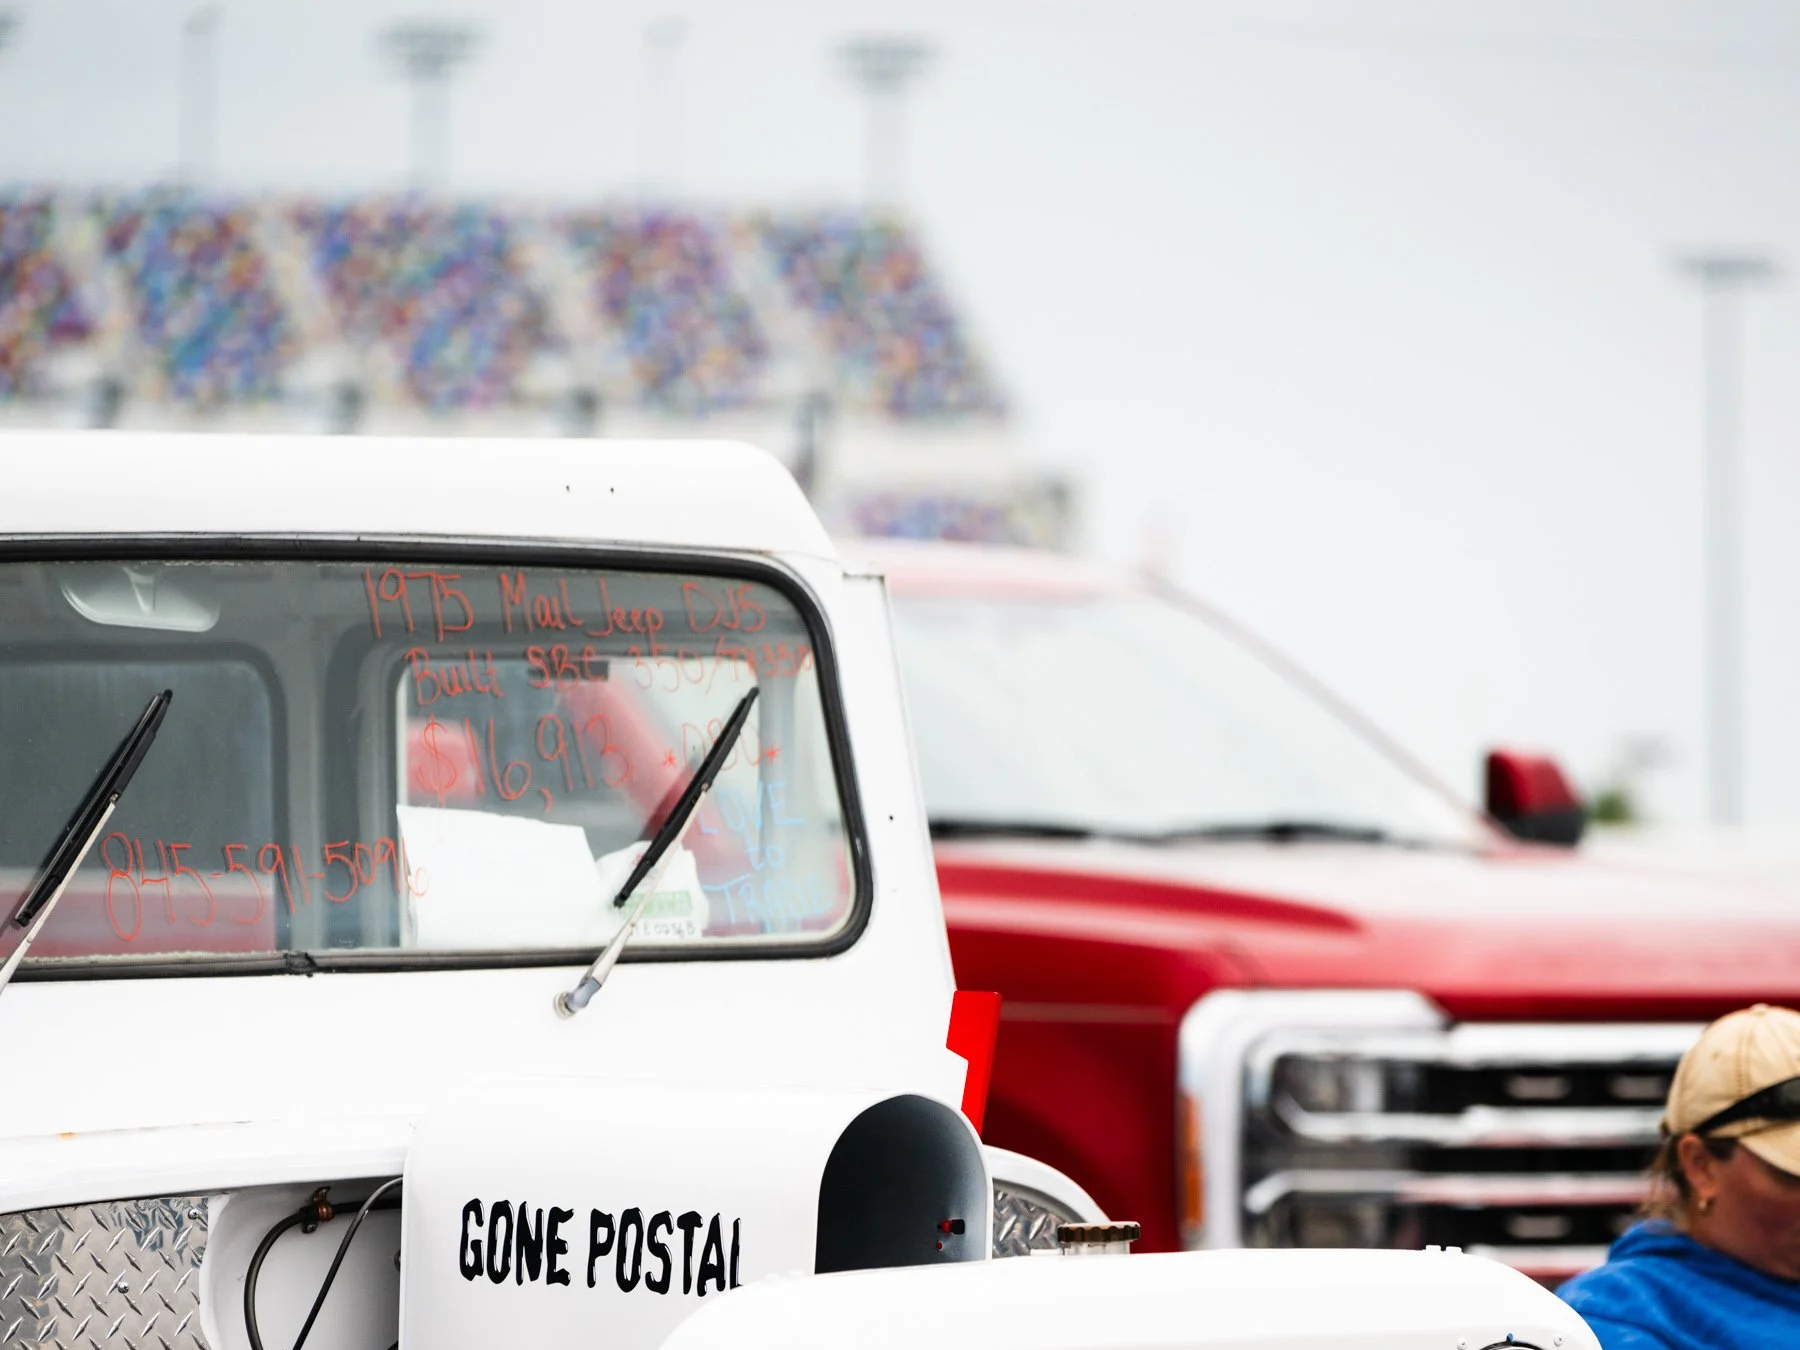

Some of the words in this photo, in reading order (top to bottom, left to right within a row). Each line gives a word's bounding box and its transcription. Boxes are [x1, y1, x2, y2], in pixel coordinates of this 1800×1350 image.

[365, 567, 474, 643] 1975
[501, 570, 584, 634] Mail
[586, 576, 664, 642] Jeep
[682, 581, 767, 634] DJ5
[404, 647, 504, 706] Built
[526, 643, 608, 692] SBC
[415, 712, 635, 812] $16,913
[698, 780, 806, 834] LOVE
[102, 832, 429, 940] 845-591-5096
[459, 1197, 575, 1286] GONE
